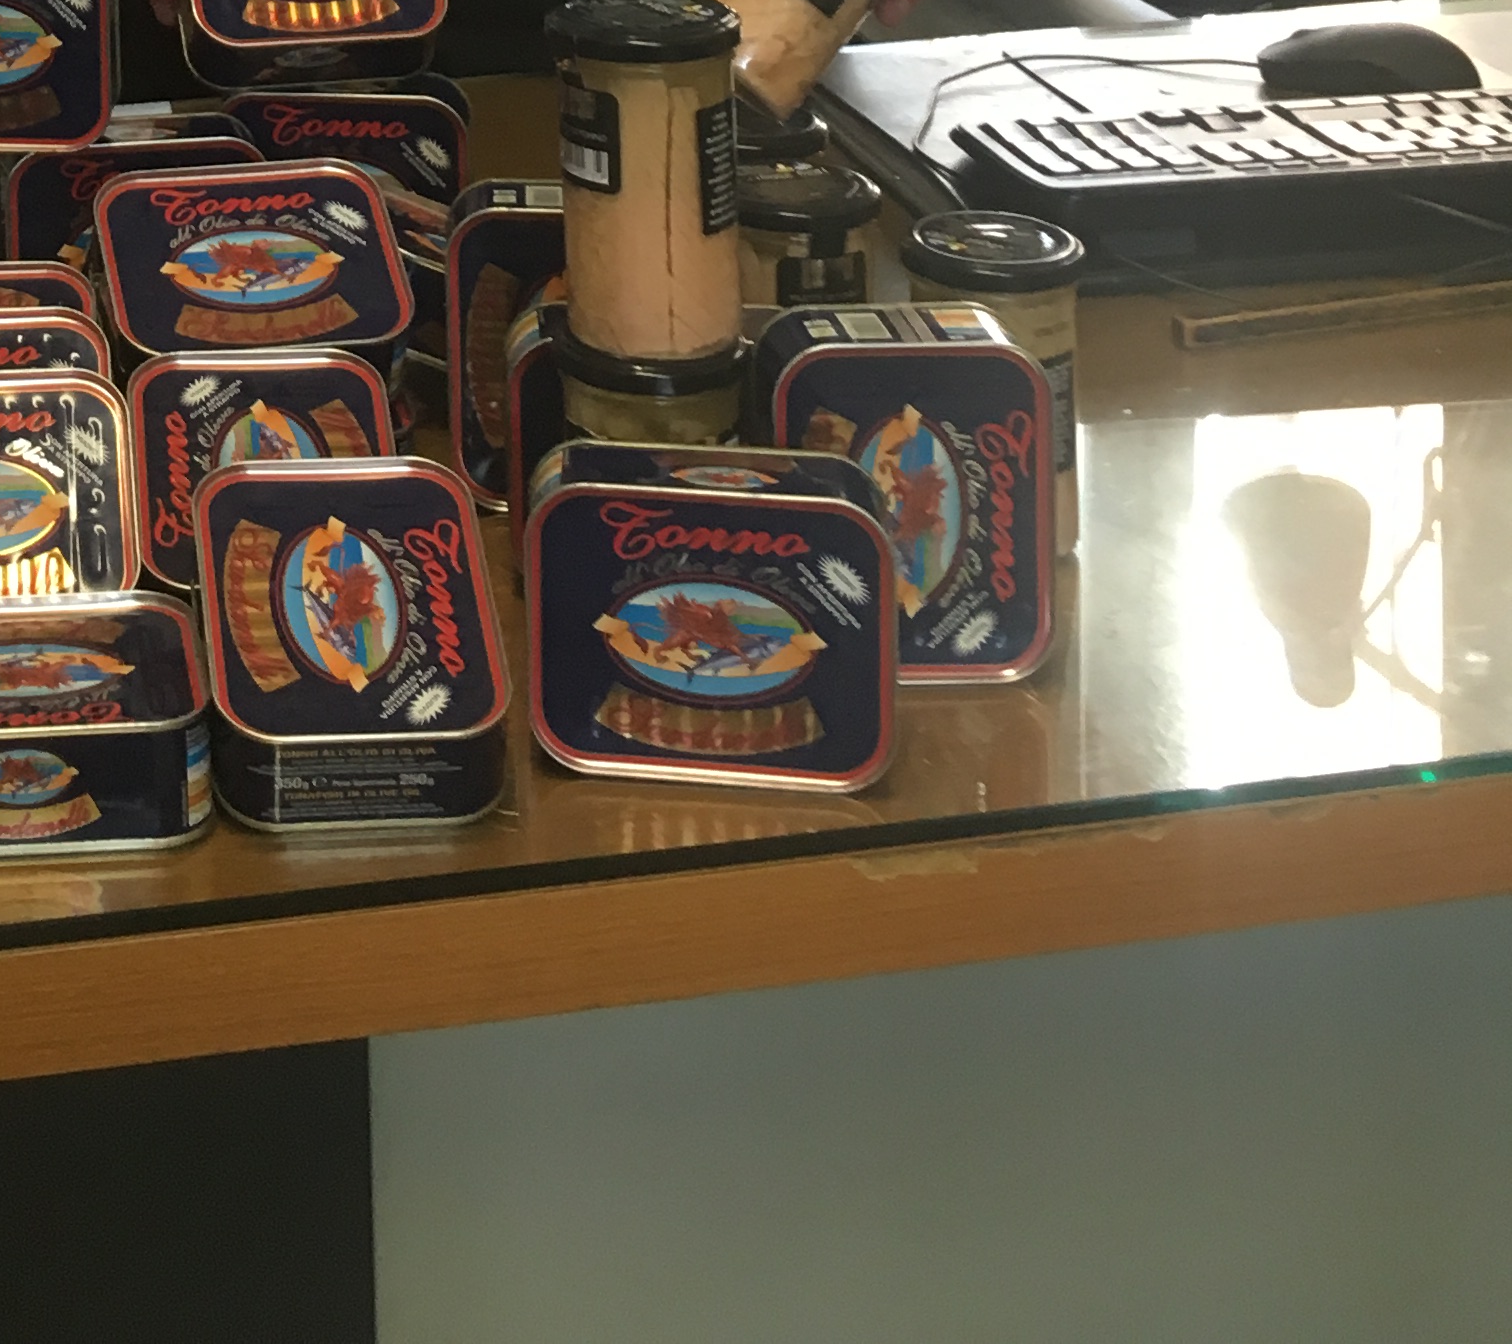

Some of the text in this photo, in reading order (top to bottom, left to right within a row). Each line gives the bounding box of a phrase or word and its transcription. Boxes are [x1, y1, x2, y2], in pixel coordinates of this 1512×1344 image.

[263, 103, 411, 147] Tonno
[149, 187, 316, 225] Tonno
[199, 213, 241, 234] Olio
[245, 213, 267, 226] di
[275, 214, 331, 241] Oliva
[153, 410, 194, 548] Tonno
[599, 500, 812, 560] Tonno
[974, 410, 1034, 603] Tonno
[393, 558, 423, 601] Olio
[403, 518, 466, 678] Tonno
[406, 602, 428, 627] di
[386, 630, 429, 684] Oliva
